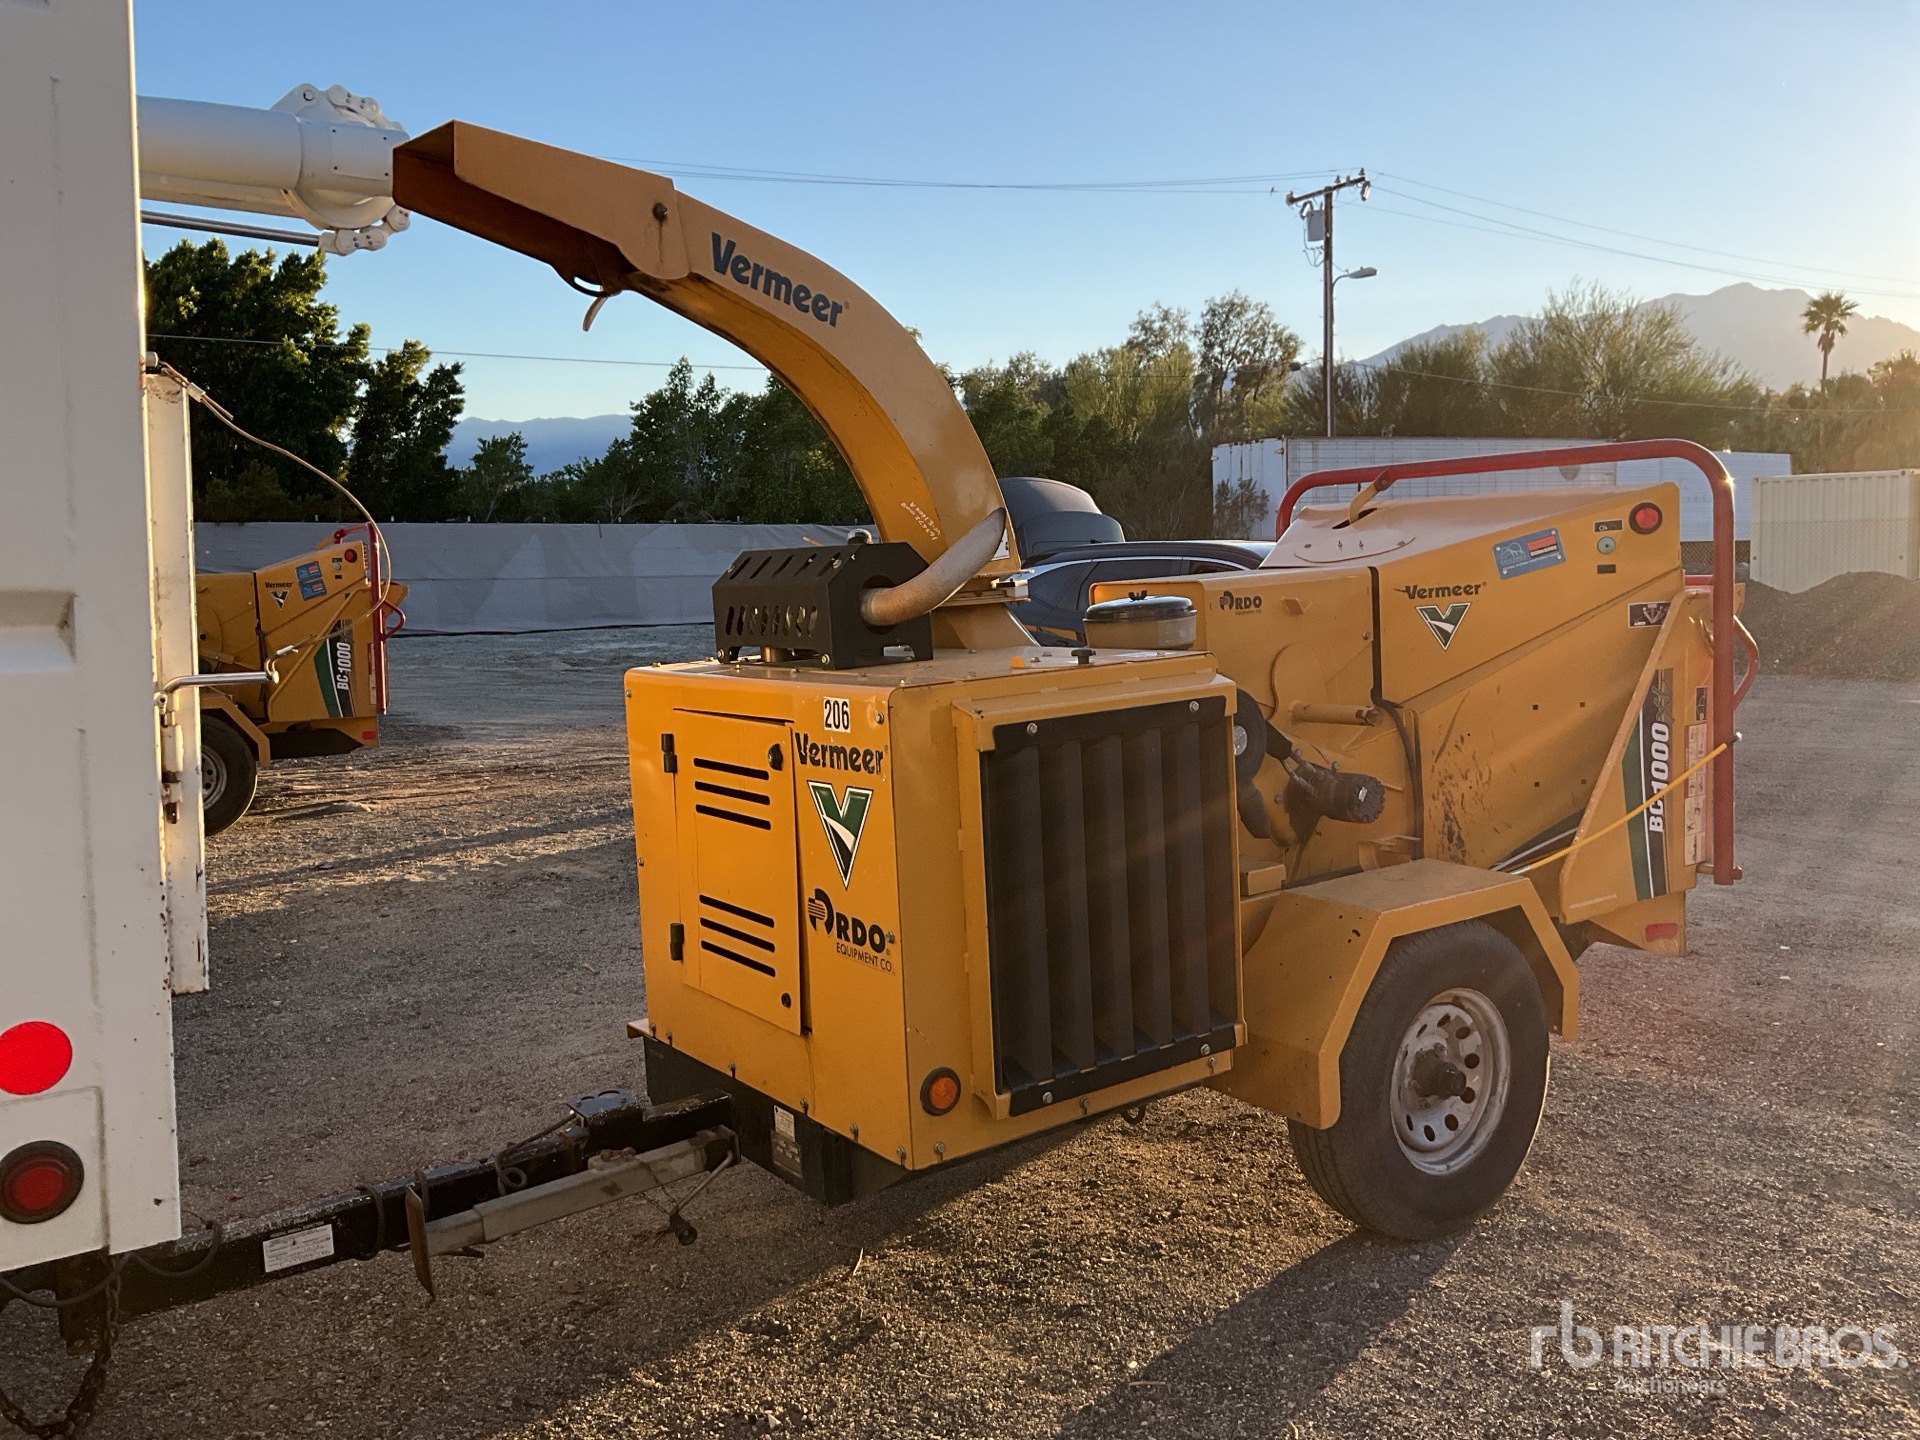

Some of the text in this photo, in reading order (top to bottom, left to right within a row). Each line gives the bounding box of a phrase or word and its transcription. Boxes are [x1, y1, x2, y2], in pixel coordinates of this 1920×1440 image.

[712, 232, 843, 328] Vermeer
[1405, 583, 1482, 600] Vermeer
[336, 642, 352, 690] BC1000
[824, 699, 850, 731] 206
[795, 733, 883, 774] Vermeer
[1649, 722, 1669, 832] BC1000
[836, 942, 879, 968] EQUIPMENT
